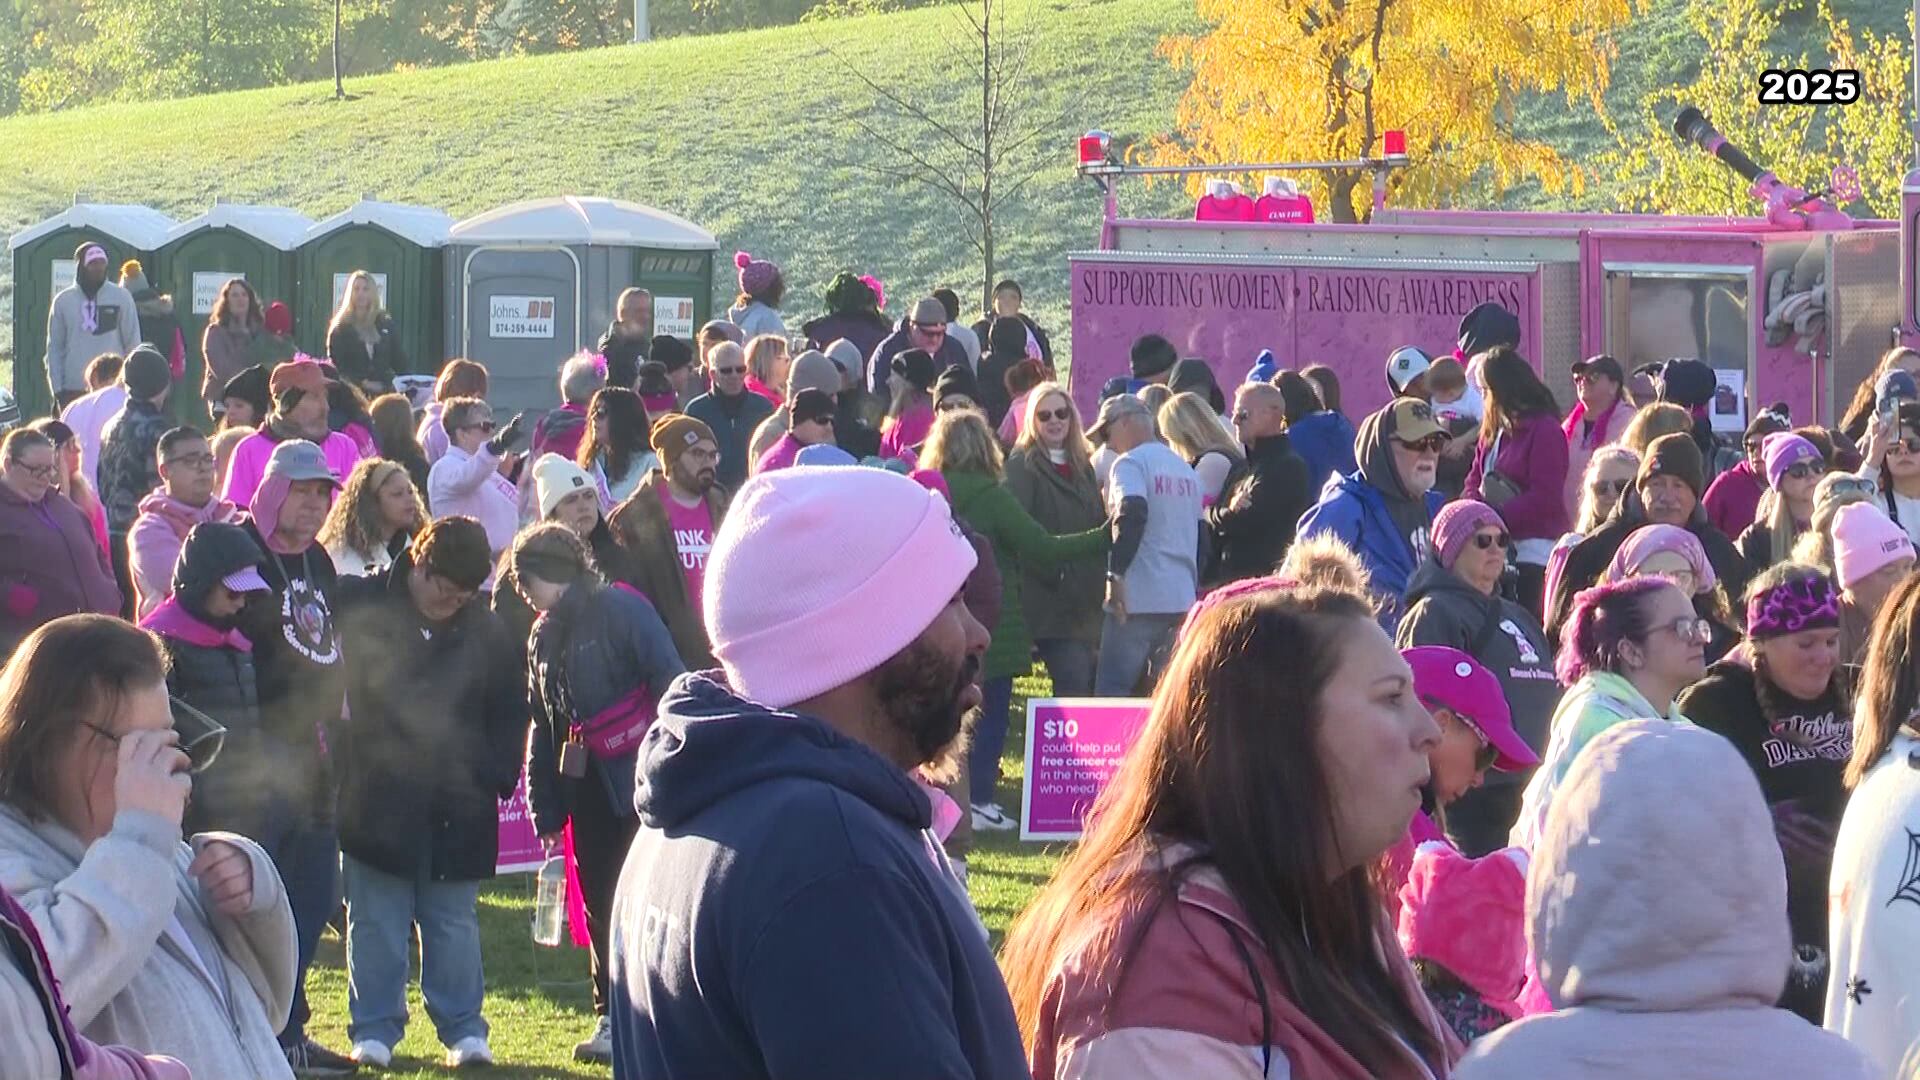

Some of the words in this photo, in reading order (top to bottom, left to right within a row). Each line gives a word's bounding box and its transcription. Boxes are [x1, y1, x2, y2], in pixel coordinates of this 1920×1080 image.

[1083, 269, 1204, 308] SUPPORTING
[1209, 272, 1286, 310] WOMEN
[1308, 275, 1392, 314] RAISING
[1397, 277, 1521, 316] AWARENESS
[679, 552, 704, 570] UT
[1043, 719, 1079, 740] $10
[1042, 742, 1073, 753] could
[1076, 742, 1100, 756] help
[1103, 743, 1121, 756] put
[1041, 756, 1066, 766] free
[1066, 757, 1106, 766] cancer
[1040, 770, 1050, 780] in
[1053, 770, 1071, 780] the
[1074, 770, 1109, 780] hands
[1040, 784, 1063, 794] who
[1066, 784, 1095, 794] need
